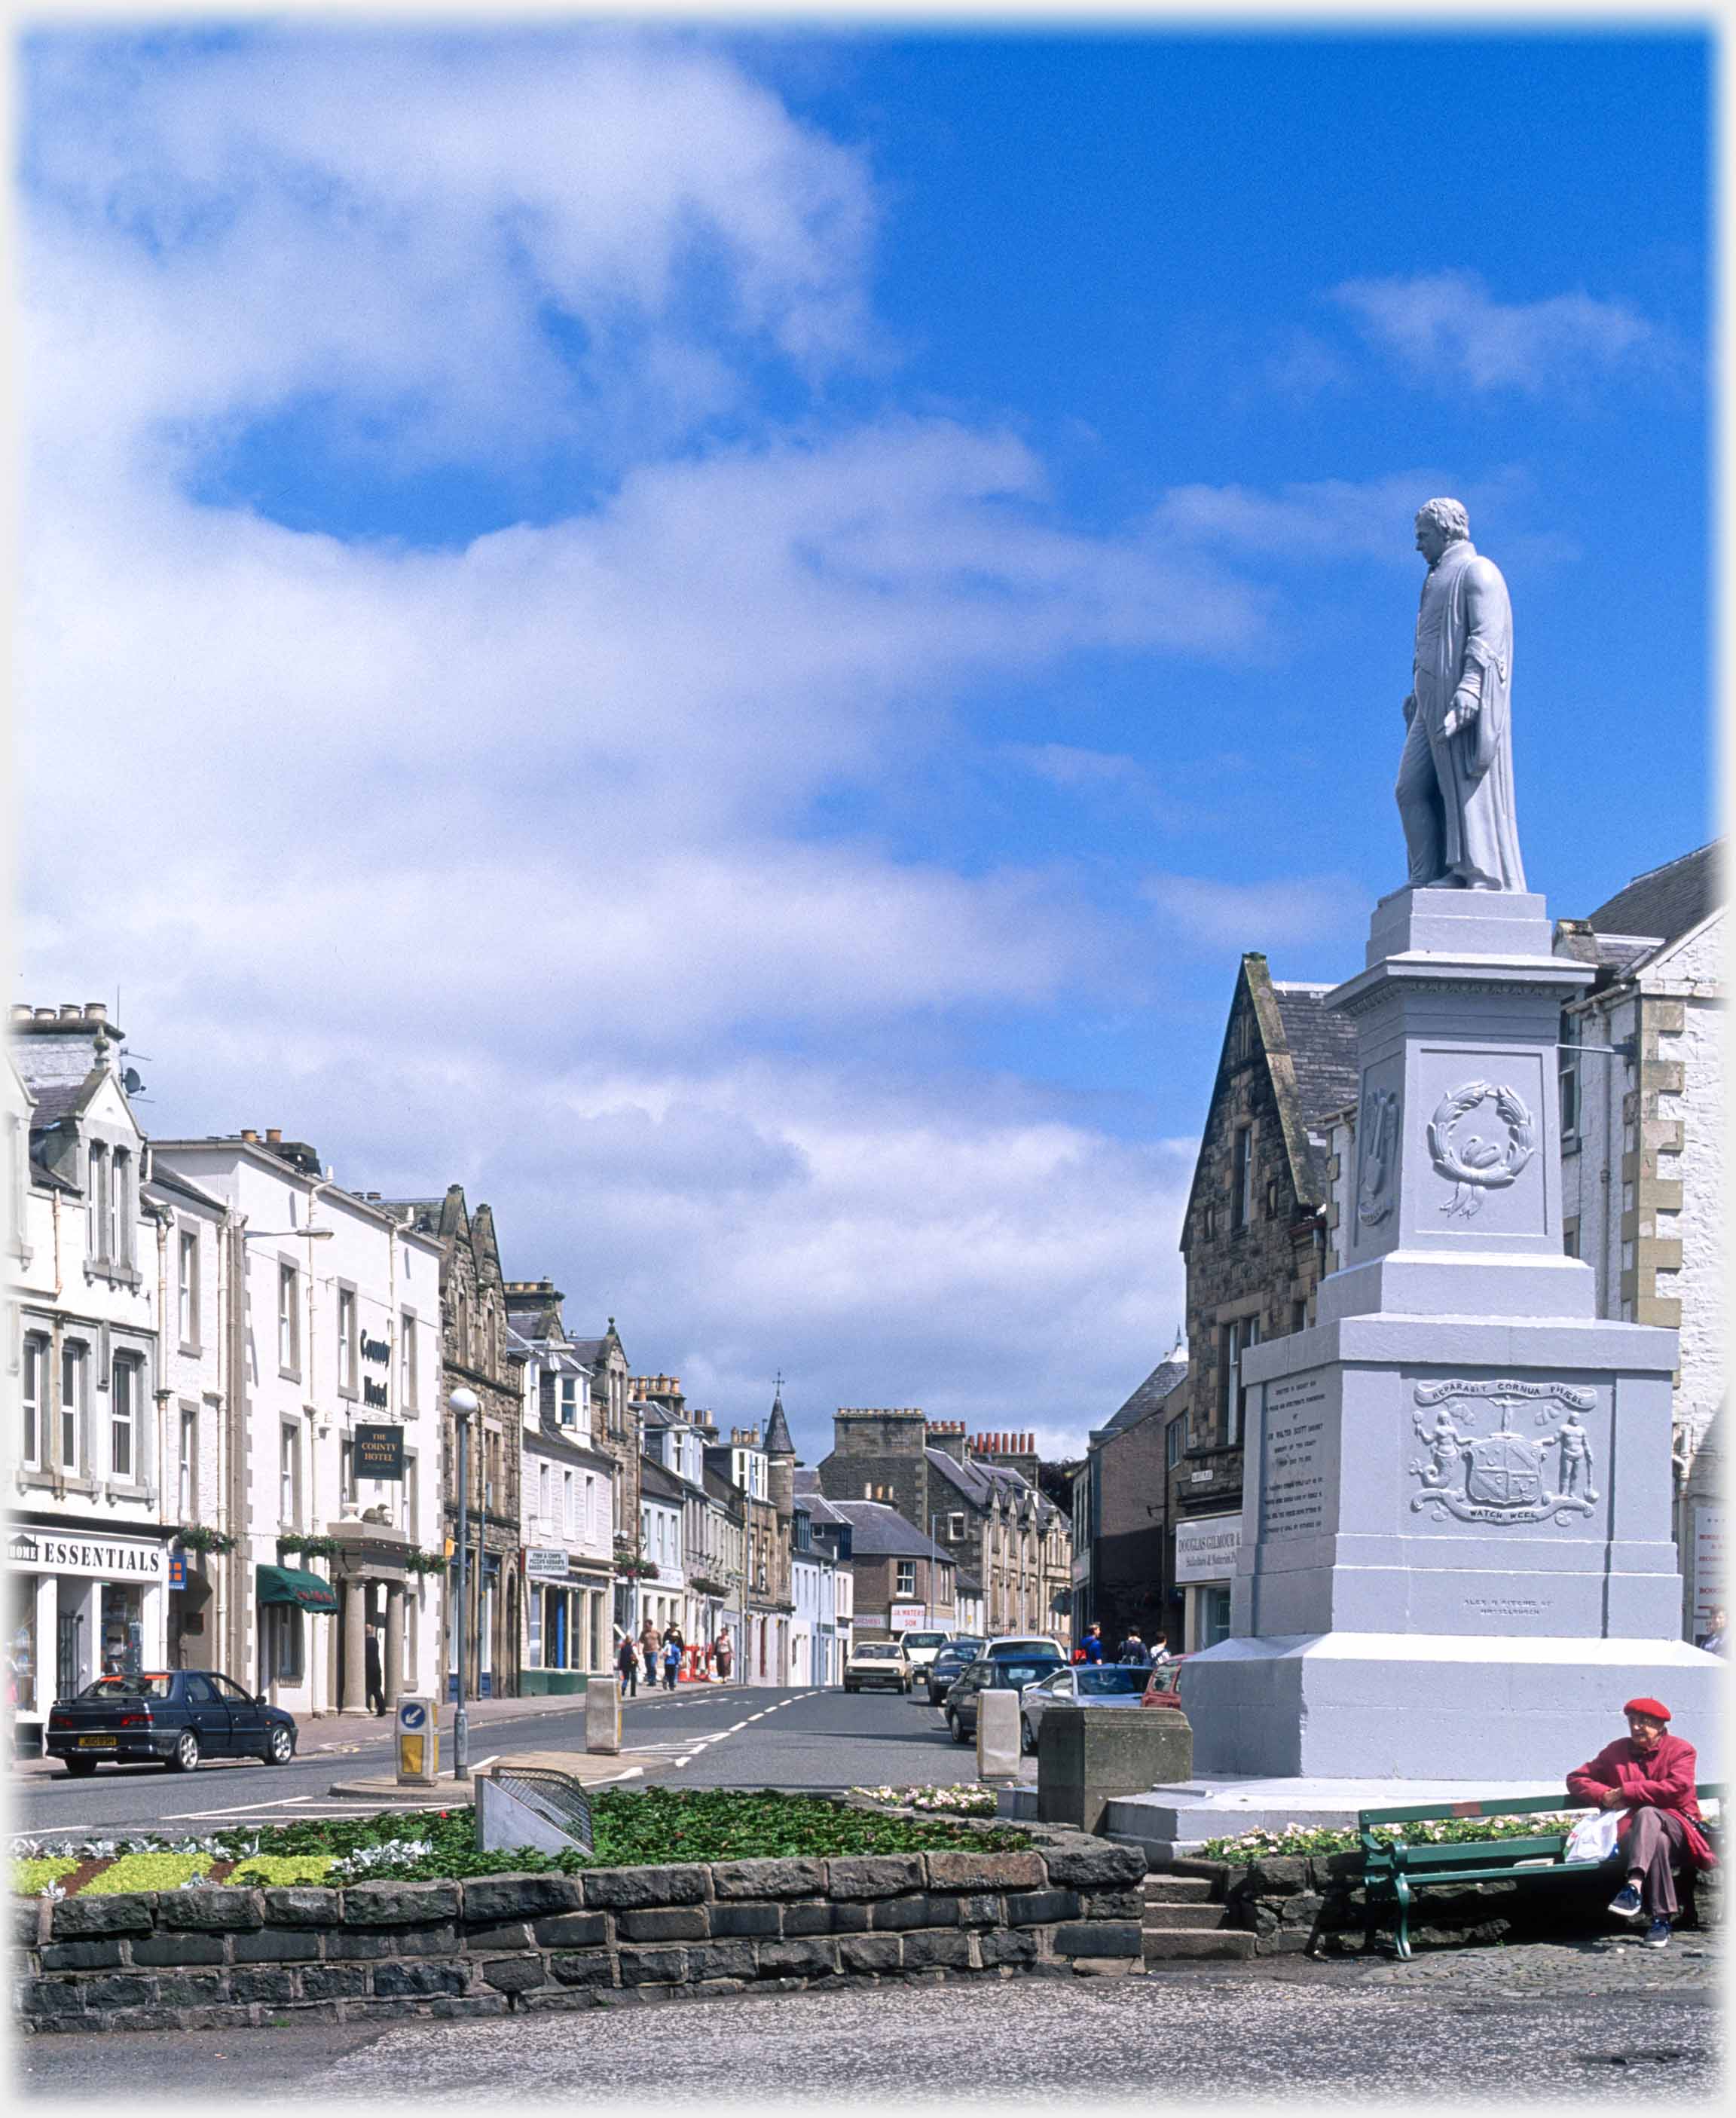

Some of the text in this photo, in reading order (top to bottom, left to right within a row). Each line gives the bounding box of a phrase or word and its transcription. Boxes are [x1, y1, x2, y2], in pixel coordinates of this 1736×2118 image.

[360, 1329, 391, 1371] County
[1432, 1383, 1487, 1399] REPARABIT
[1498, 1383, 1540, 1395] CORNUA
[362, 1442, 397, 1451] COUNTY
[364, 1453, 394, 1462] HOTEL
[1470, 1510, 1502, 1519] WATCH
[44, 1542, 160, 1572] ESSENTIALS
